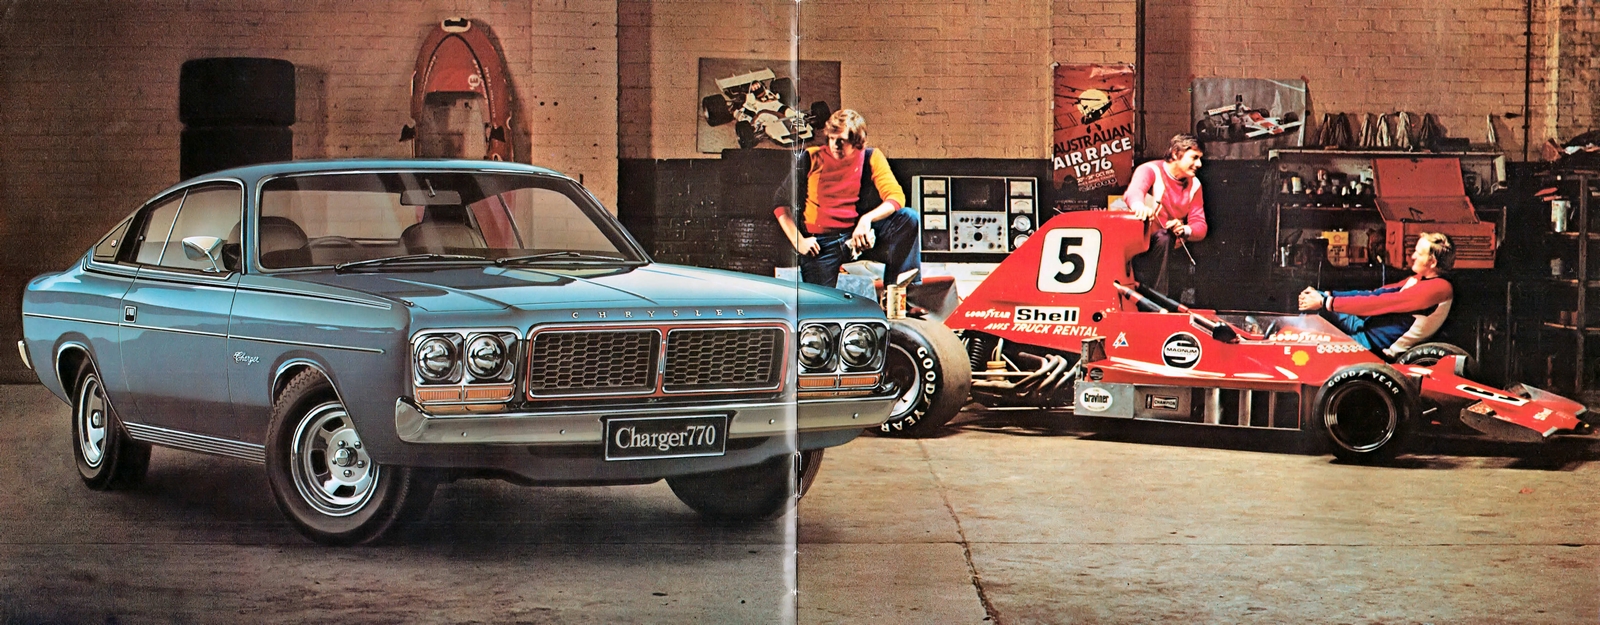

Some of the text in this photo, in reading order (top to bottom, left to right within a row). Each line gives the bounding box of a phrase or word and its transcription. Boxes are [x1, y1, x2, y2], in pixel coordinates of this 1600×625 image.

[1053, 123, 1133, 155] AUSTRALIAN
[1053, 137, 1132, 171] AIR RACE
[1073, 157, 1112, 178] 1976
[1053, 236, 1085, 284] 5
[572, 309, 745, 319] CHRYSLER
[1016, 308, 1077, 322] Shell
[984, 323, 1098, 337] AVIS TRUCK RENTAL
[1284, 346, 1291, 355] E
[1084, 392, 1109, 404] Graviner
